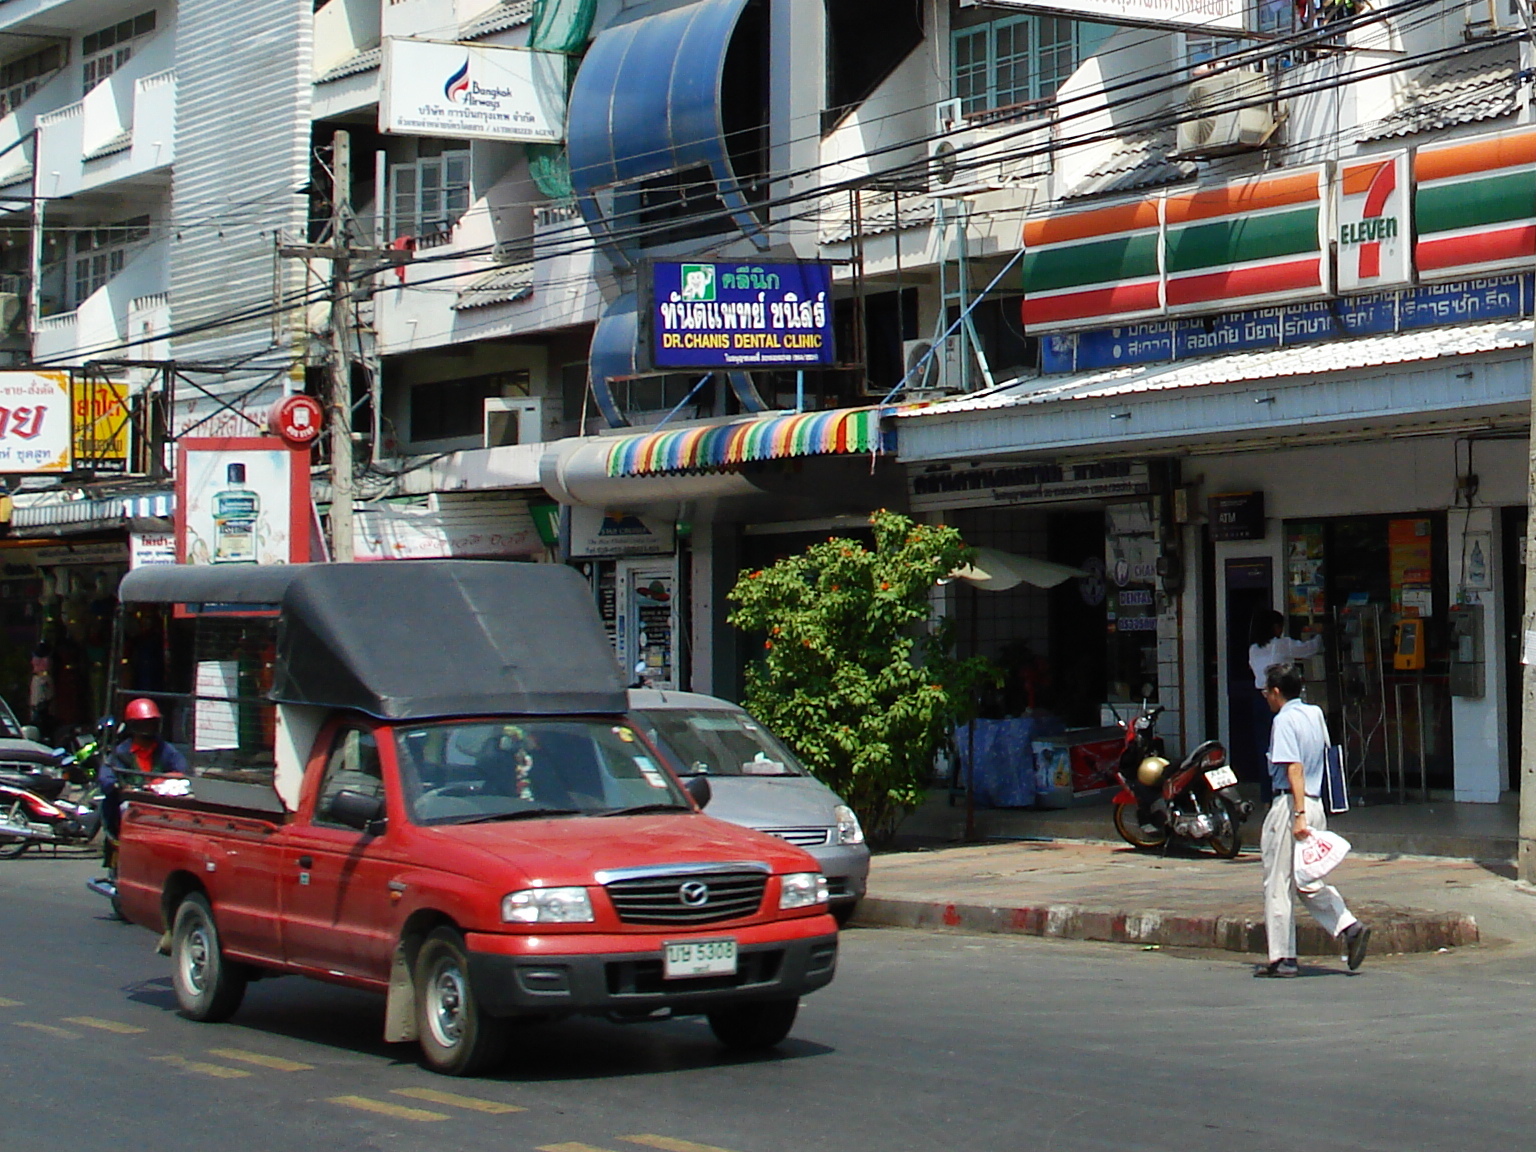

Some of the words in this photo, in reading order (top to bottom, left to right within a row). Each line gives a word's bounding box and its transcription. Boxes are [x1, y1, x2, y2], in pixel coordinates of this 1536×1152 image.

[473, 81, 512, 99] Bangkok
[418, 105, 445, 116] บริษัท
[463, 92, 500, 111] Airways
[1343, 158, 1396, 278] 7
[661, 291, 765, 330] ทันตแพทย์
[663, 333, 730, 348] DR.CHANIS
[734, 333, 781, 348] DENTAL
[784, 333, 822, 348] CLINIC
[1219, 512, 1236, 523] ATM
